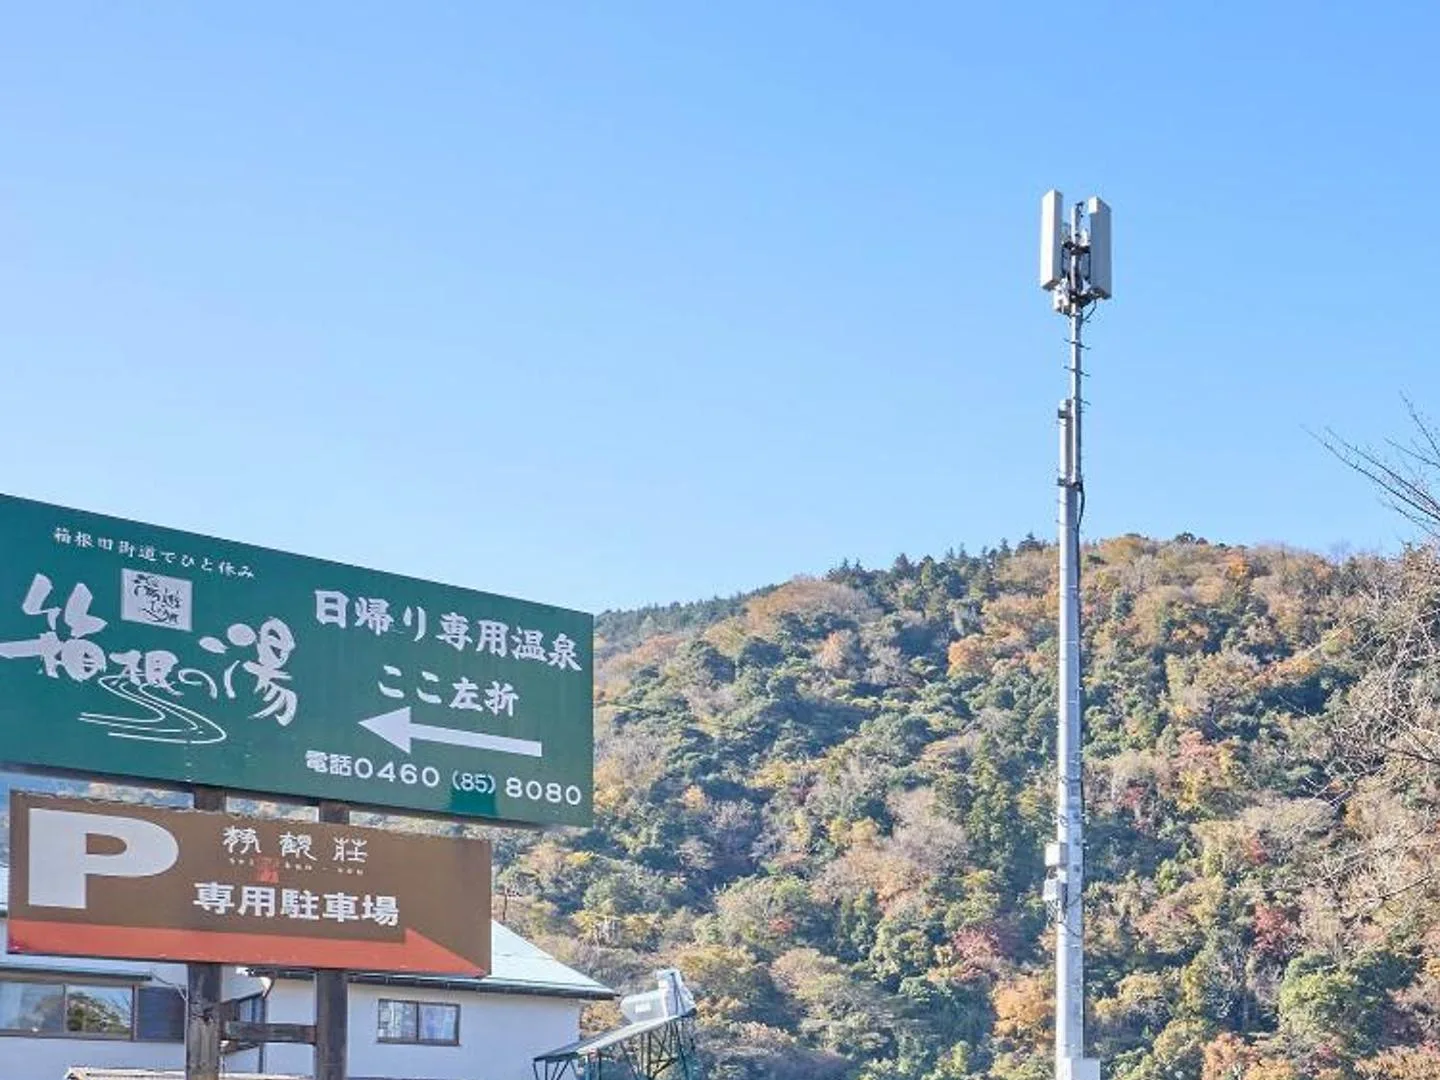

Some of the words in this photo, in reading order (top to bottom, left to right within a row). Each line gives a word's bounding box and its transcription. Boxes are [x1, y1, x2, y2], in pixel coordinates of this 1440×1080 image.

[314, 589, 583, 672] 日帰り専用温泉
[377, 664, 520, 717] ここ左折
[505, 776, 582, 806] 8080
[28, 808, 180, 910] P
[193, 881, 400, 927] 専用駐車場
